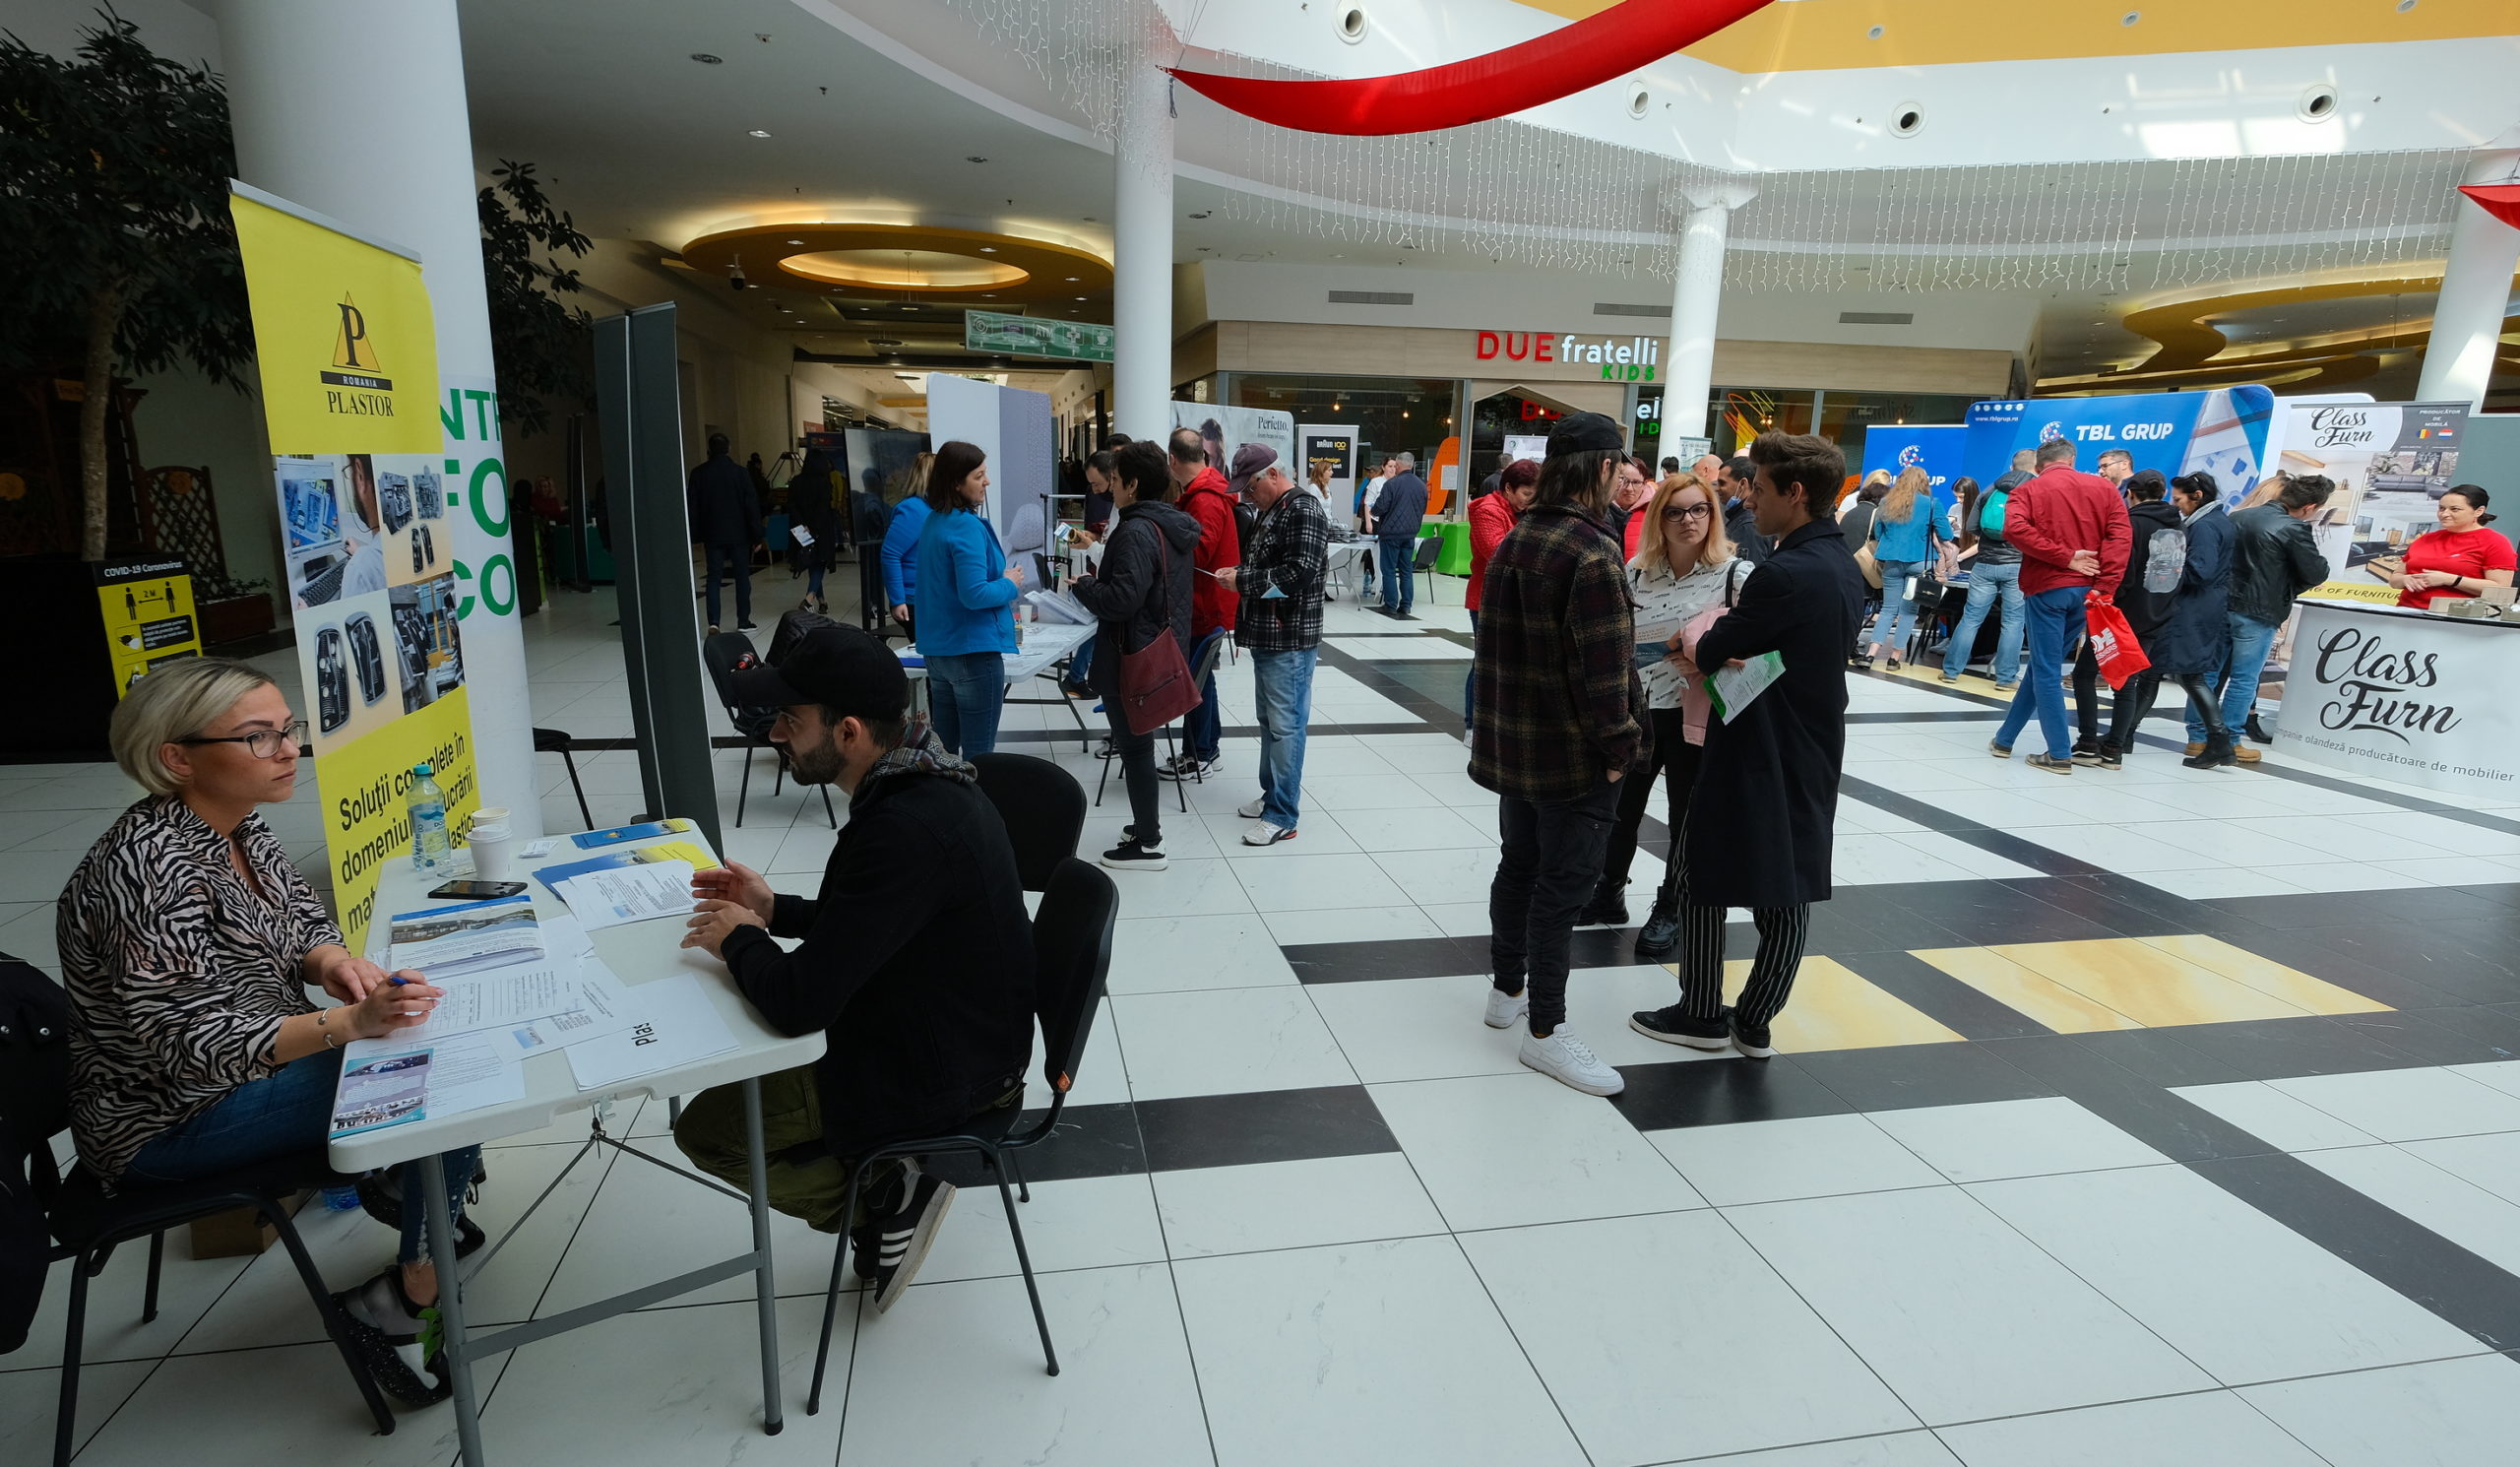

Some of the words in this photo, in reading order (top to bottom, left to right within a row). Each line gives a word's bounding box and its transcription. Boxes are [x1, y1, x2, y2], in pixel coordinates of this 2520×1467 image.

[1477, 331, 1555, 362] DUE
[1561, 334, 1658, 365] fratelli
[343, 375, 378, 389] ROMANIA
[1601, 364, 1656, 381] KIDS
[327, 390, 395, 416] PLASTOR
[2310, 407, 2367, 431] Class
[2076, 423, 2115, 442] TBL
[2121, 422, 2174, 440] GRUP
[2314, 426, 2375, 449] Furn
[103, 564, 142, 577] COVID-19
[142, 560, 184, 572] Coronavirus
[2315, 627, 2439, 688] Class
[2319, 679, 2463, 740] Furn
[395, 742, 455, 797] coplete
[454, 732, 466, 758] în
[2304, 734, 2346, 752] olandeză
[2347, 744, 2426, 769] producătoare
[2430, 760, 2448, 773] de
[2452, 764, 2516, 783] mobilier
